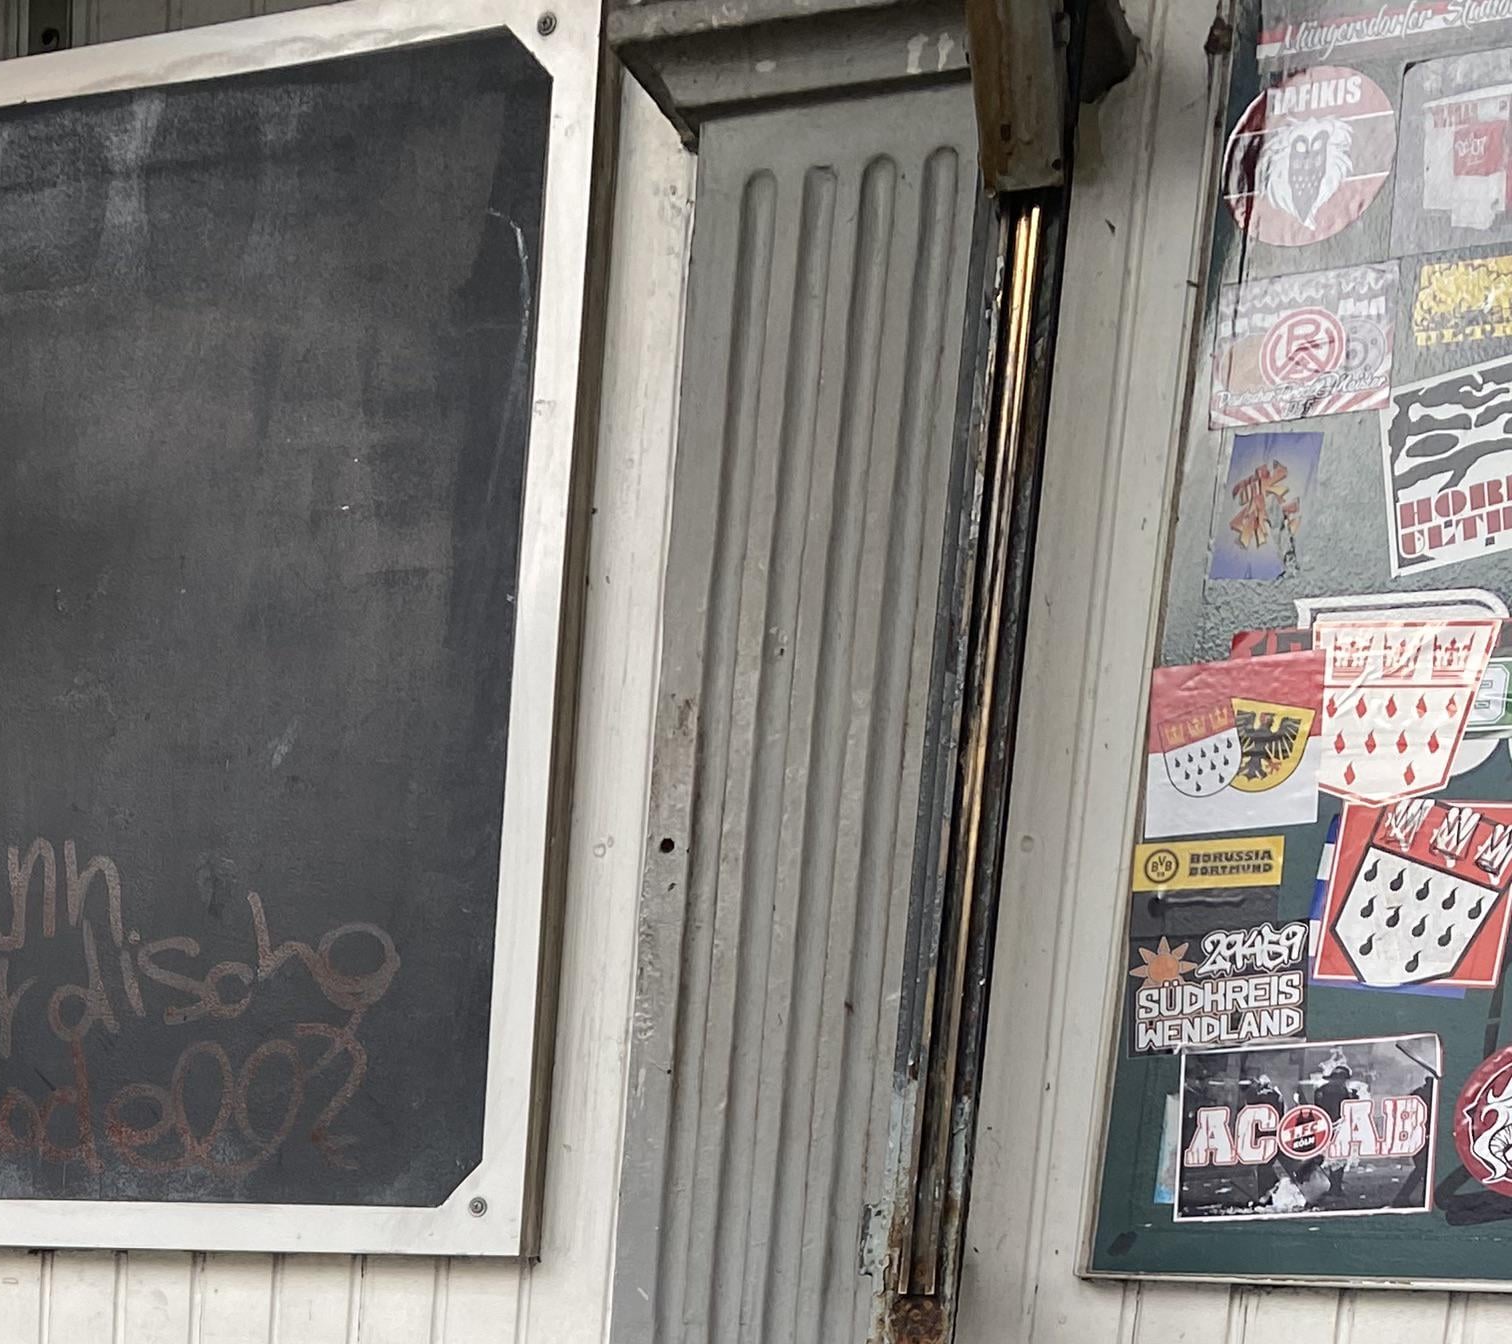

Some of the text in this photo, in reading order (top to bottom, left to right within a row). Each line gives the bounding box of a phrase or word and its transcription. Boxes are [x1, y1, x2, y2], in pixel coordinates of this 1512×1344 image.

[1399, 474, 1512, 530] HOR
[1151, 855, 1173, 873] BVB
[1189, 862, 1273, 877] DORTMUND
[1190, 849, 1273, 865] BORUSSIA
[1137, 972, 1302, 1020] SÜDKREIS
[1137, 1007, 1302, 1050] WENDLAND
